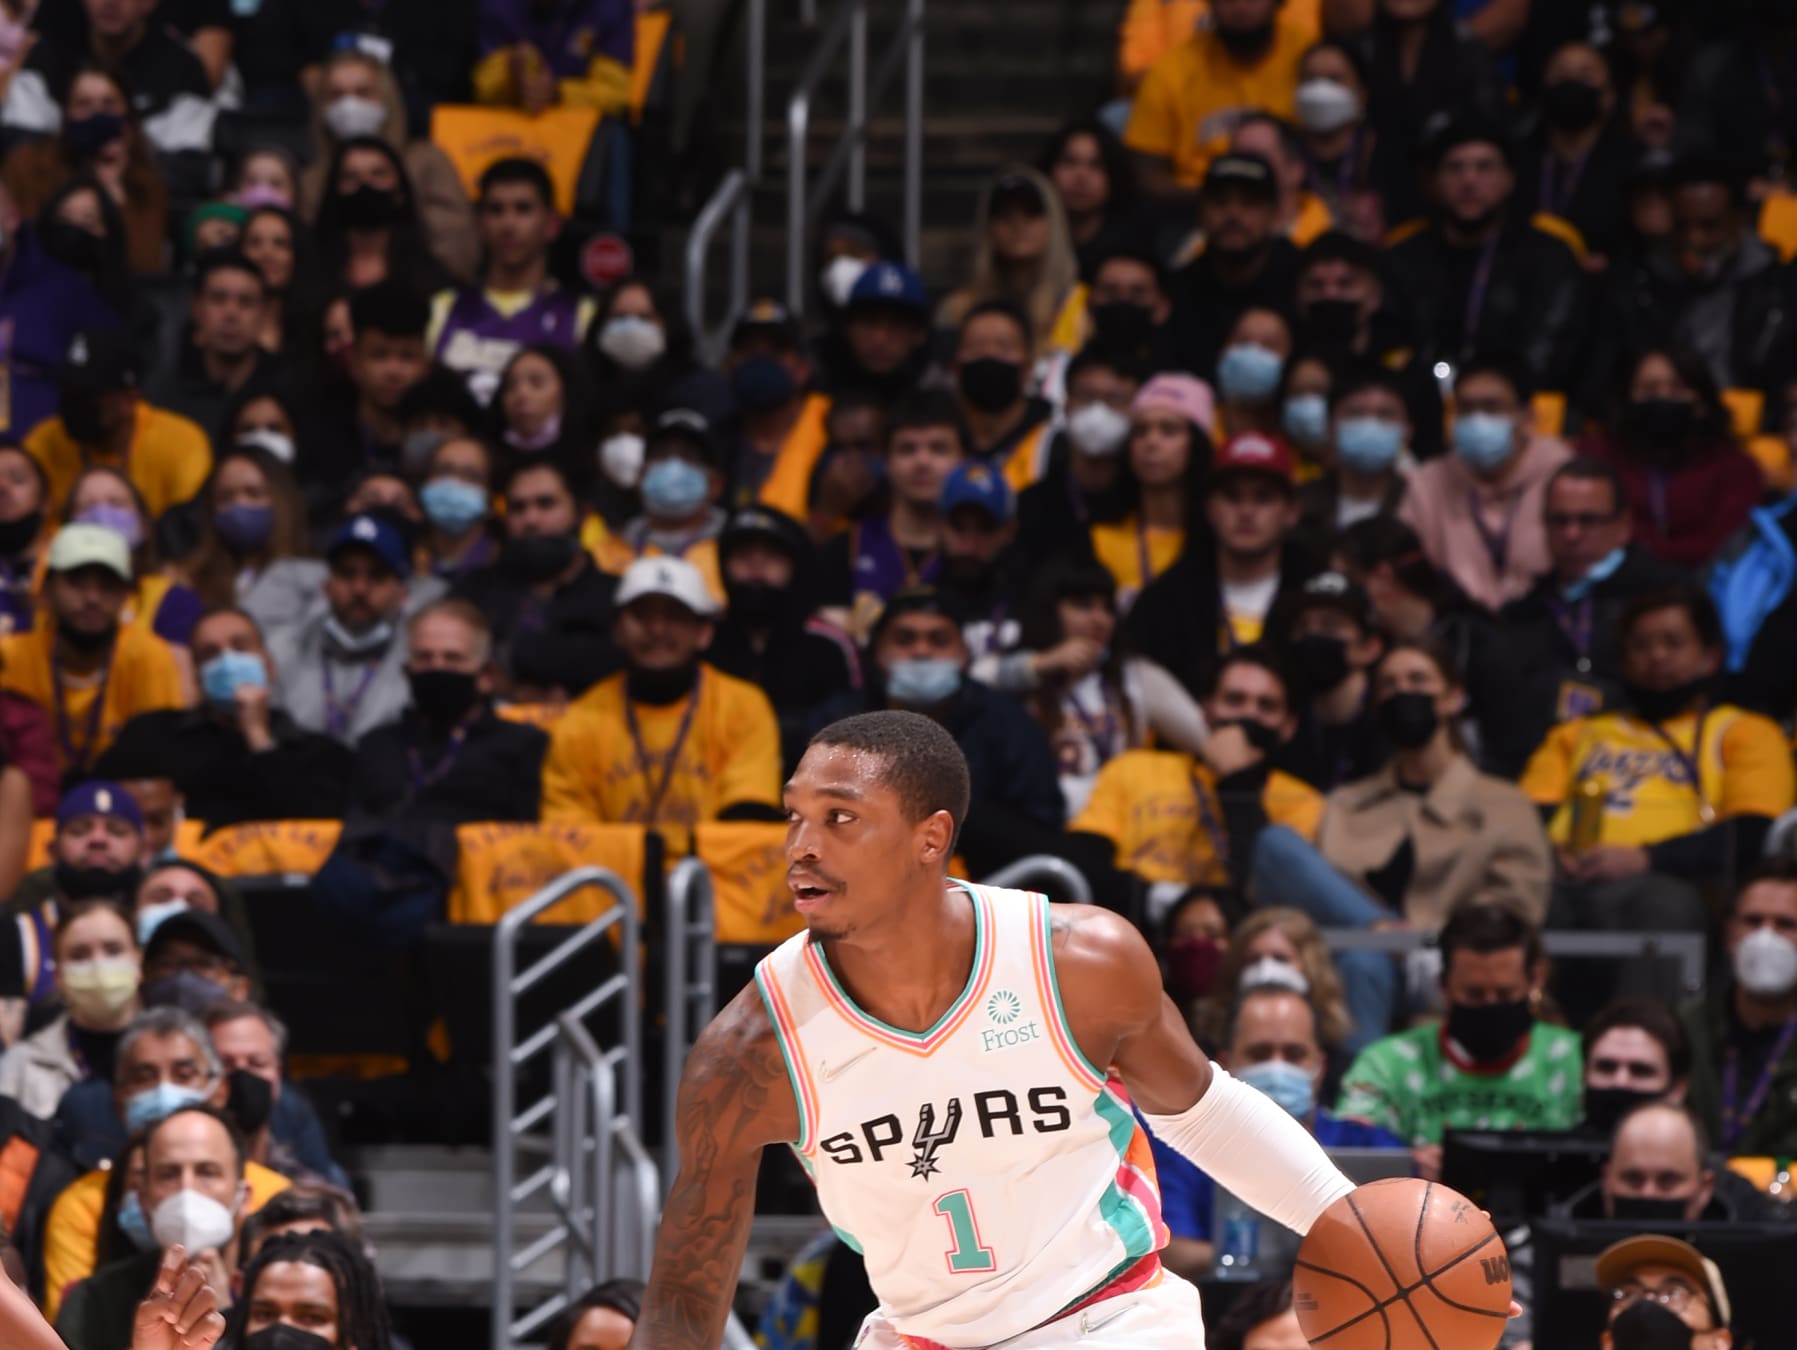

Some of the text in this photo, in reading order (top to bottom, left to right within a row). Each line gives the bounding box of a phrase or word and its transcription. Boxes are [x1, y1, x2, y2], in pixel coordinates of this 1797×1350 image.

[981, 1021, 1040, 1051] Frost
[819, 1085, 1072, 1181] SPURS
[932, 1187, 996, 1274] 1
